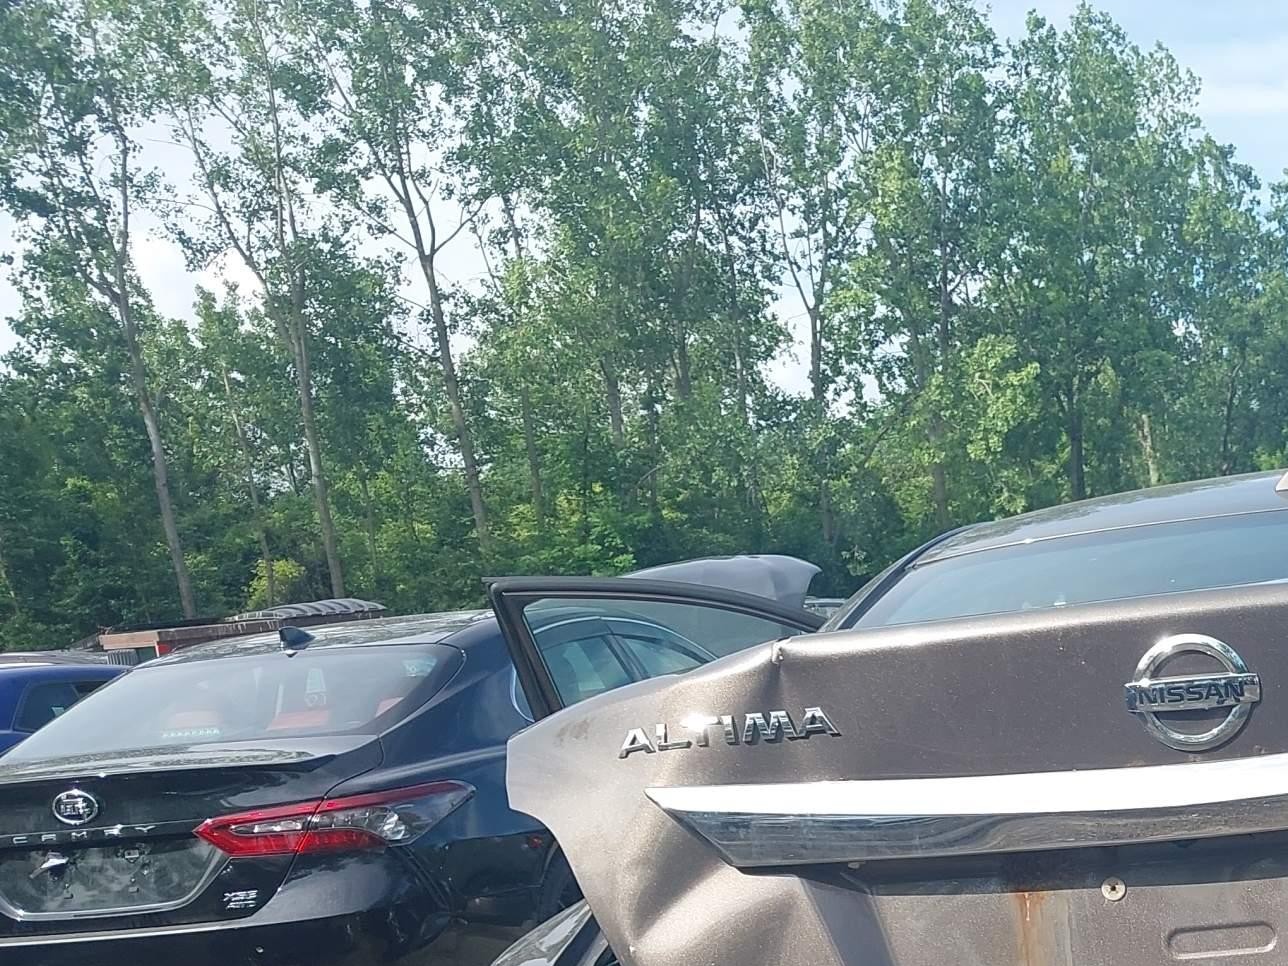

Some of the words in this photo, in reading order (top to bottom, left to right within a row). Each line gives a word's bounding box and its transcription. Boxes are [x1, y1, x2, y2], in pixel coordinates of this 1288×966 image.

[1138, 679, 1246, 706] NISSAN
[618, 706, 842, 759] ALTIMA
[12, 824, 156, 845] CAMRY
